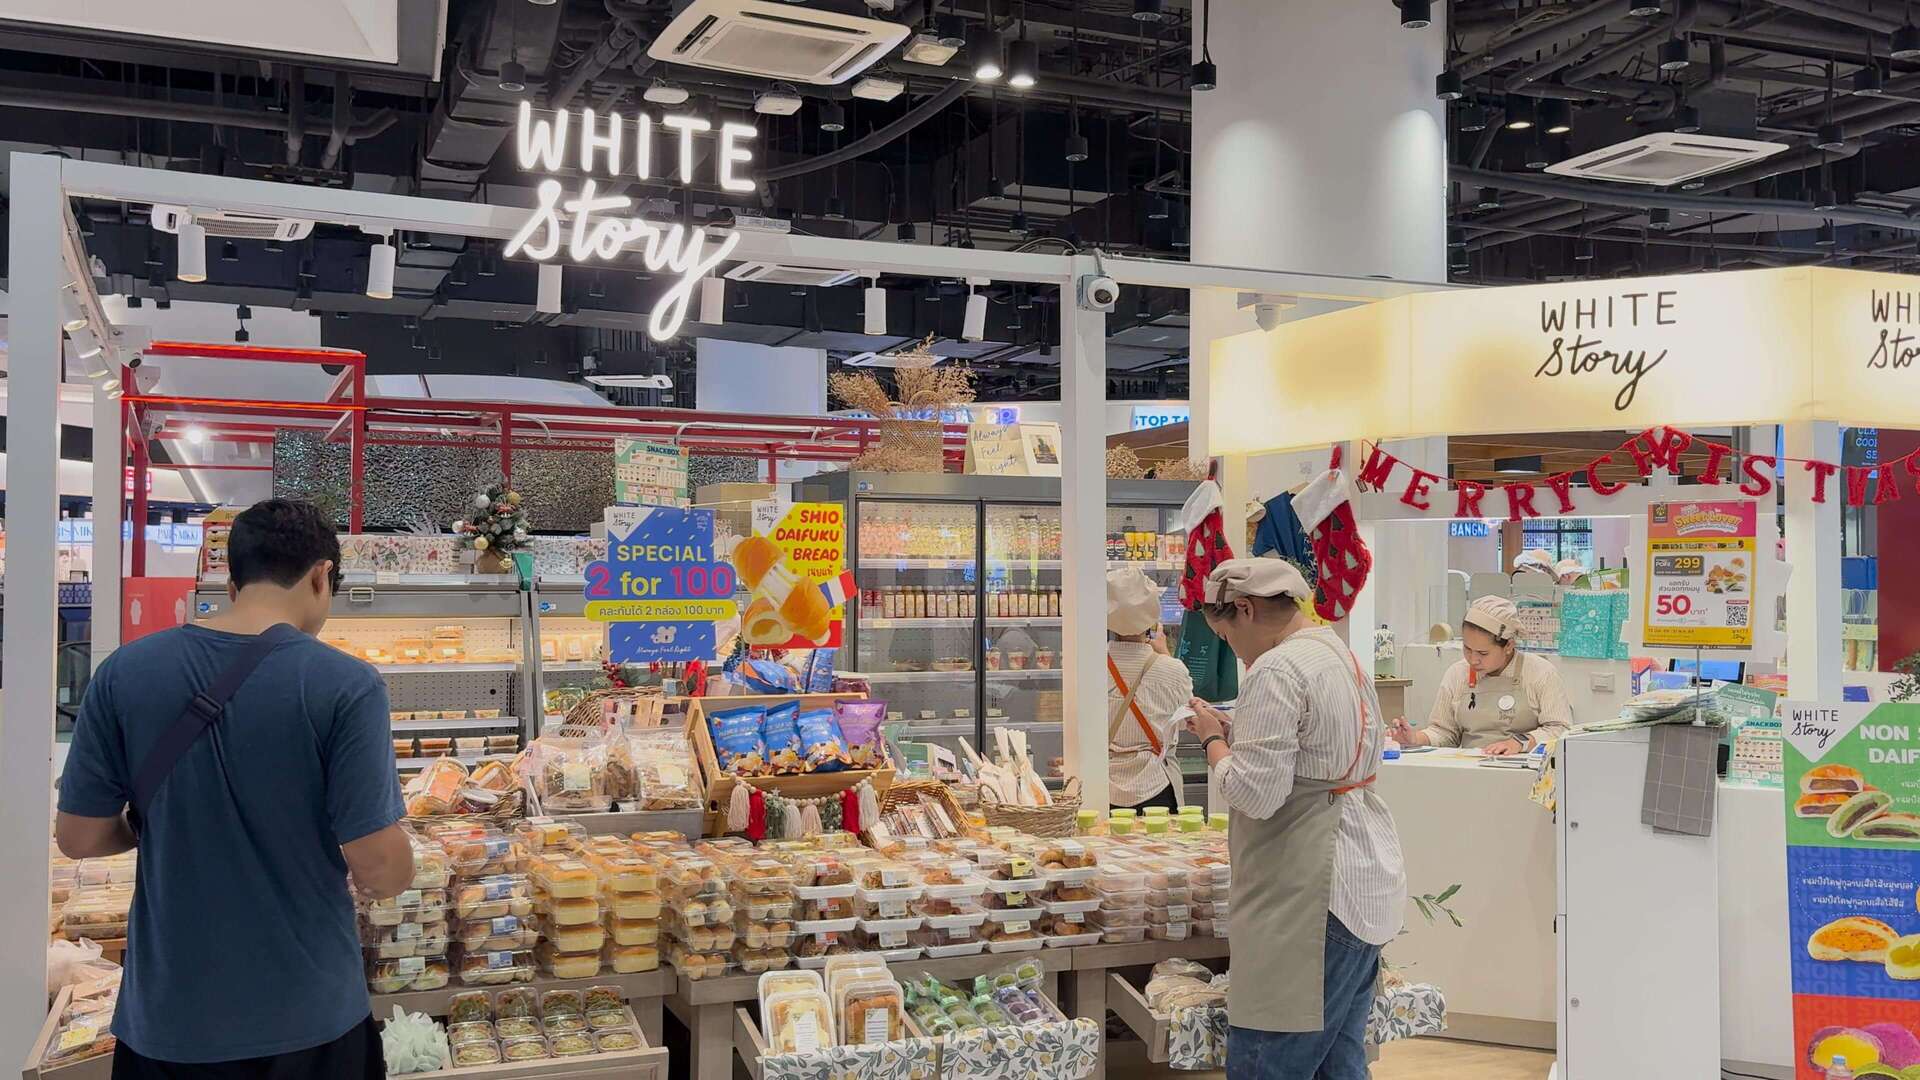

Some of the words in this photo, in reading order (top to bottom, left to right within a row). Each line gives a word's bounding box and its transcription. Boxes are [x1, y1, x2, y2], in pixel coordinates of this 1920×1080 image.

[517, 100, 757, 191] WHITE
[503, 179, 740, 341] Story
[1541, 291, 1677, 332] WHITE
[1866, 328, 1920, 368] Sto
[1534, 334, 1668, 411] Story
[646, 446, 680, 456] SNACKBOX
[1358, 446, 1576, 522] MERRY
[613, 511, 636, 519] WHITE
[800, 510, 840, 524] SHIO
[775, 528, 840, 542] DAIFUKU
[1451, 522, 1488, 536] BANGNA
[617, 545, 707, 561] SPECIAL
[793, 548, 840, 561] BREAD
[1674, 558, 1700, 569] 299
[590, 566, 610, 596] 2
[620, 571, 662, 596] for
[670, 566, 732, 596] 100
[645, 606, 653, 616] 2
[684, 605, 703, 615] 100
[705, 606, 724, 615] บาท
[1656, 594, 1691, 615] 50
[1793, 709, 1839, 722] WHITE
[1791, 722, 1836, 749] Story
[1860, 724, 1909, 740] NON
[1869, 748, 1920, 764] DAIF
